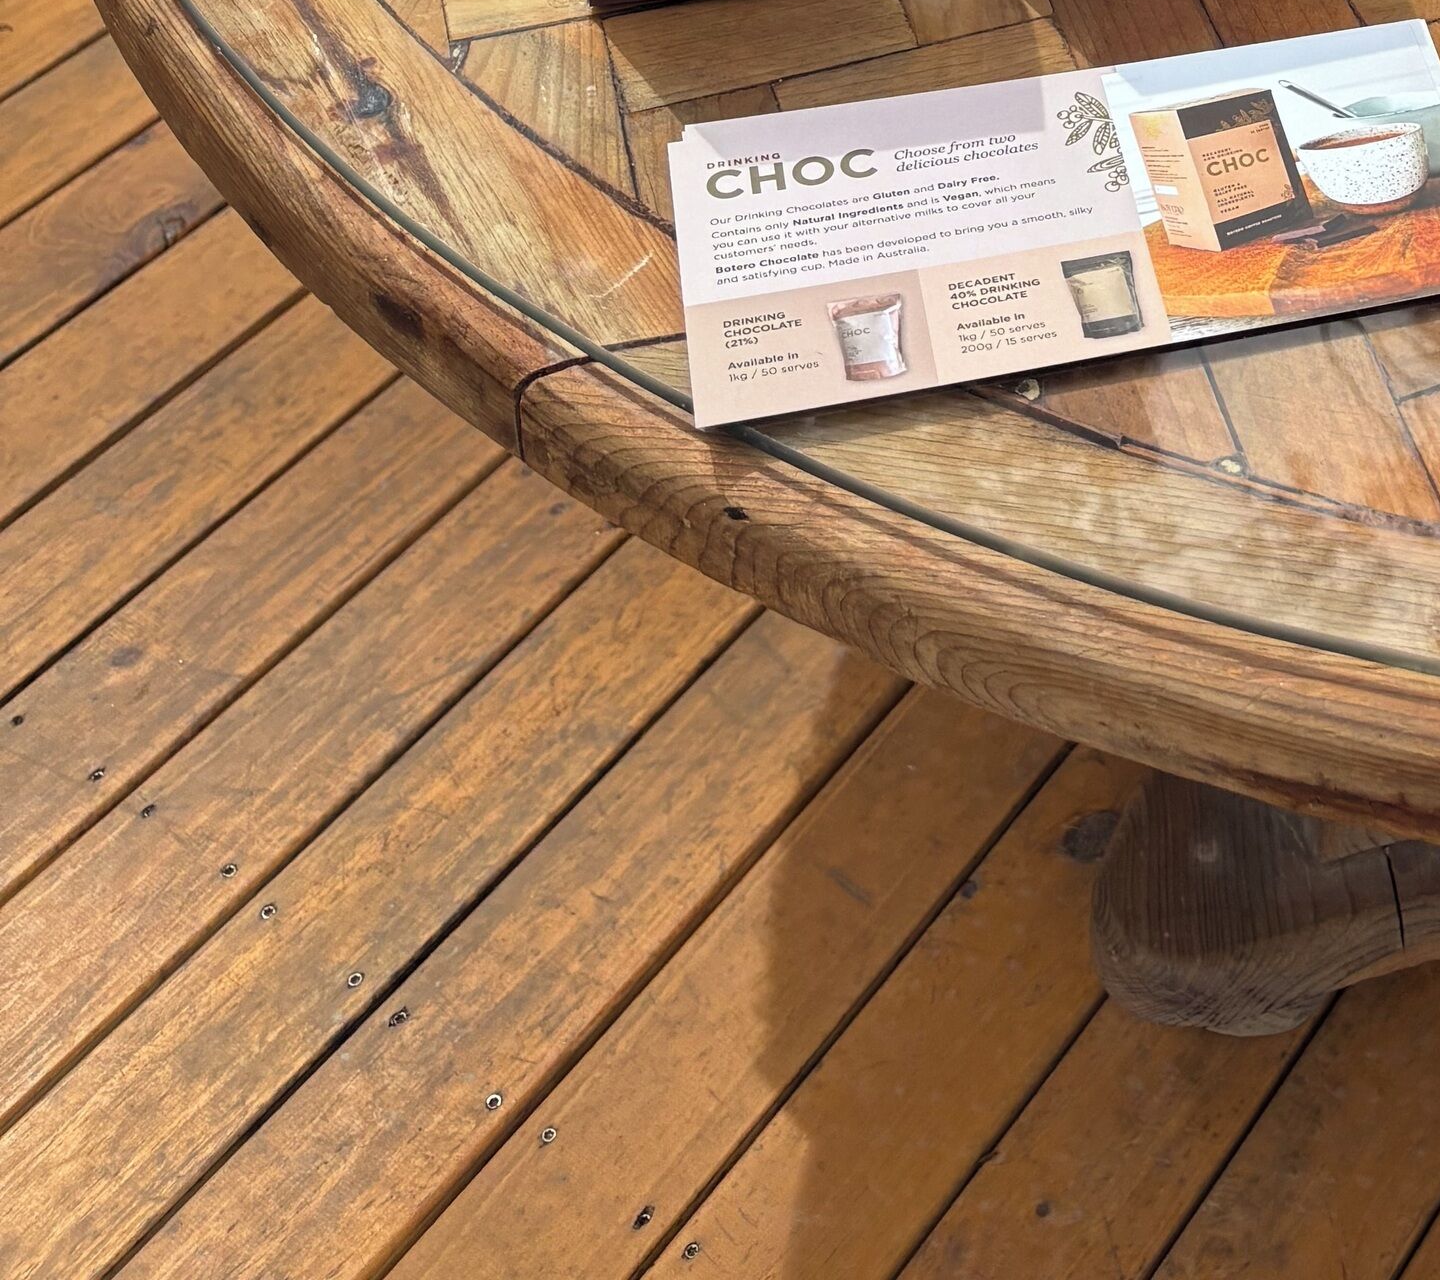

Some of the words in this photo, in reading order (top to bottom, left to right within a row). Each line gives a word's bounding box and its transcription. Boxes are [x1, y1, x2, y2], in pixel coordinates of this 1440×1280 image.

[894, 146, 946, 160] Choose
[947, 139, 984, 155] from
[989, 135, 1016, 145] two
[707, 152, 780, 170] DRINKING
[896, 156, 960, 172] delicious
[963, 143, 1038, 161] chocolates
[1206, 148, 1270, 176] CHOC
[706, 148, 878, 199] CHOC
[948, 273, 1015, 291] DECADENT
[950, 290, 977, 300] 40%
[980, 278, 1040, 295] DRINKING
[952, 290, 1028, 310] CHOCOLATE
[723, 312, 786, 328] DRINKING
[724, 319, 802, 338] CHOCOLATE
[725, 336, 758, 349] (21%)
[839, 327, 870, 340] CHOC
